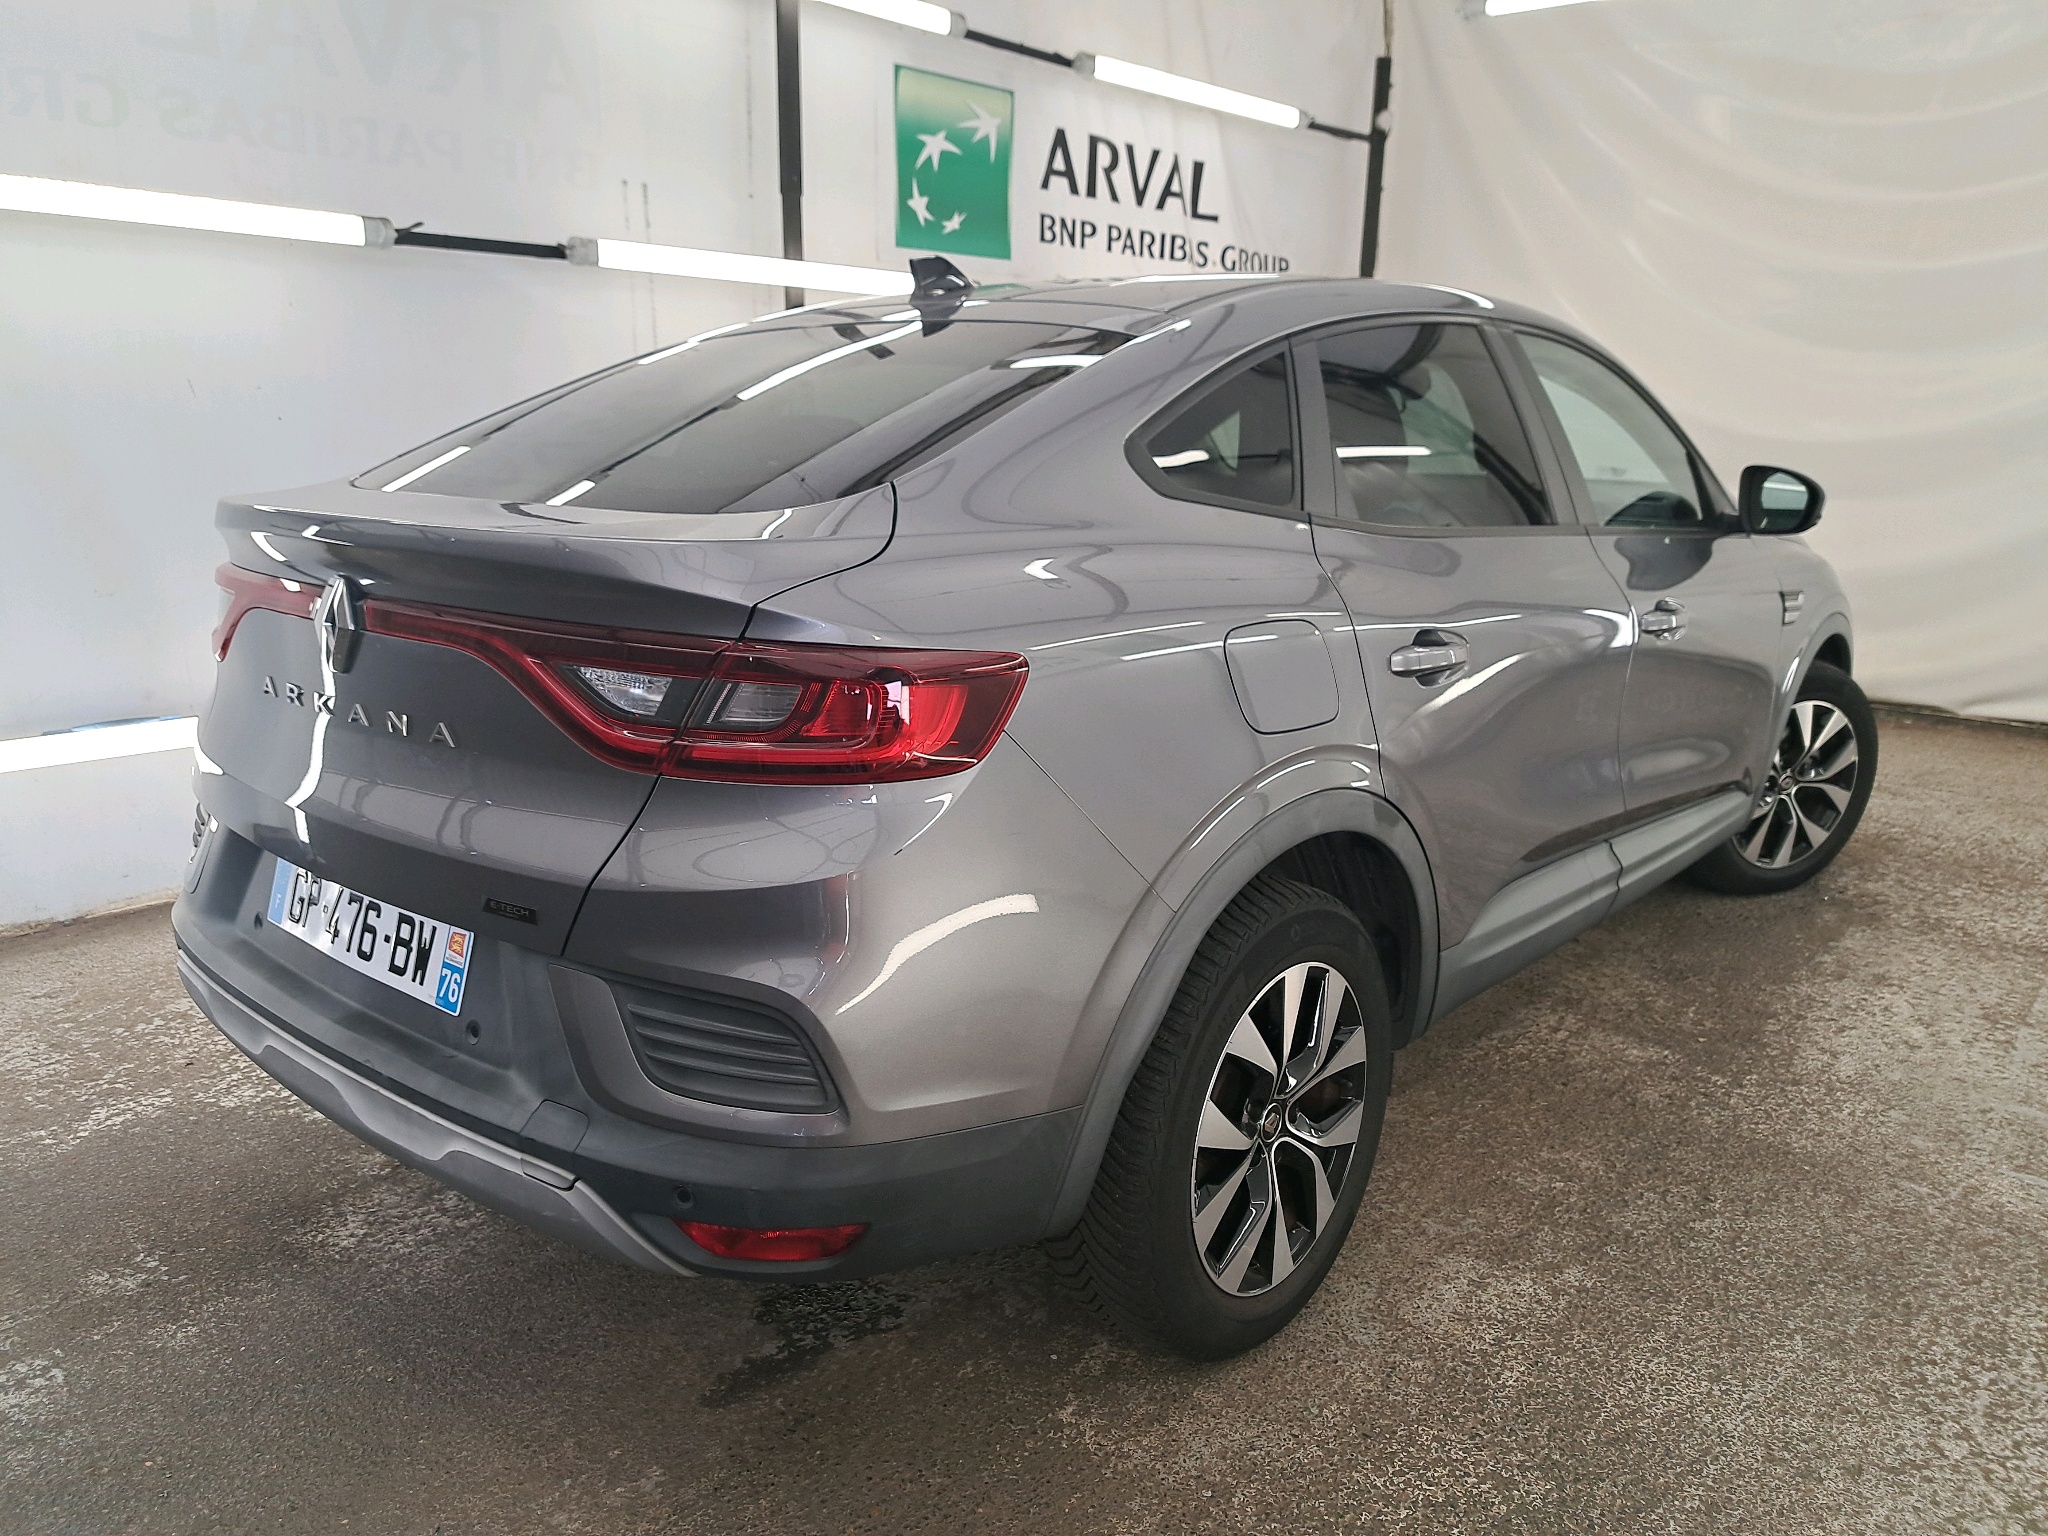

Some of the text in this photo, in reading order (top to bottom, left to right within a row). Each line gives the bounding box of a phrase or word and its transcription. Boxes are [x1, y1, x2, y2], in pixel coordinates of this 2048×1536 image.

[1041, 127, 1220, 223] ARVAL
[1040, 213, 1097, 251] BNP
[262, 675, 456, 748] ARKANA
[289, 868, 437, 986] GP-476-BW
[490, 900, 529, 917] E-TECH
[438, 967, 461, 1004] 76
